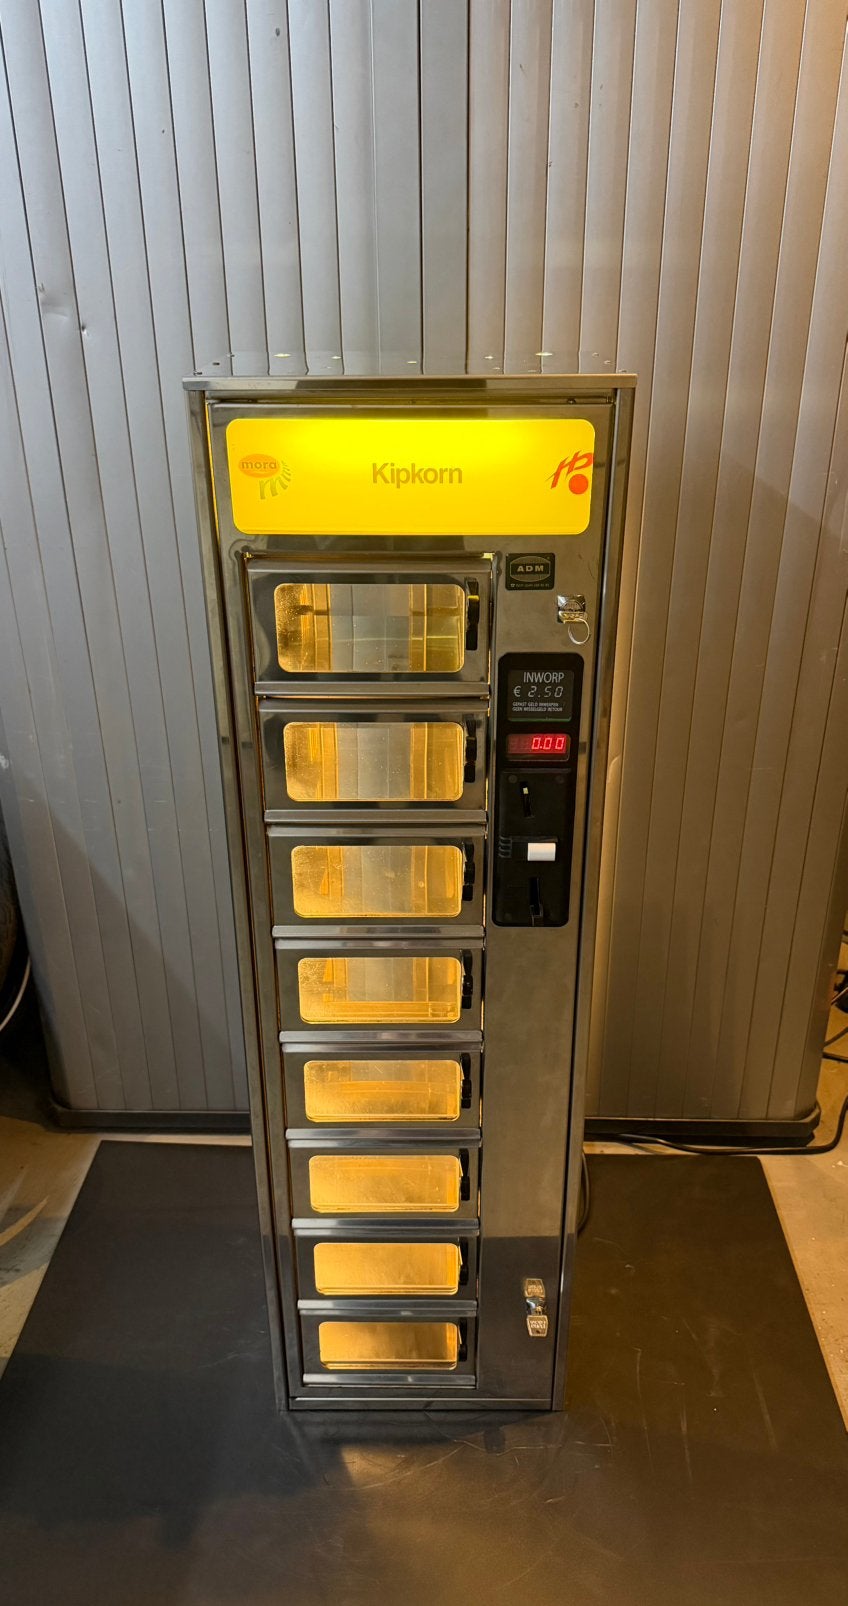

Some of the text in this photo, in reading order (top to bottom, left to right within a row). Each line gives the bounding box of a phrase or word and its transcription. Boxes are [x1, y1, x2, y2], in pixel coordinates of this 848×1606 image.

[241, 461, 277, 470] mora
[372, 462, 463, 489] Kipkorn
[523, 671, 565, 683] INWORP
[513, 685, 564, 698] € 2.50
[531, 737, 565, 750] 0.00
